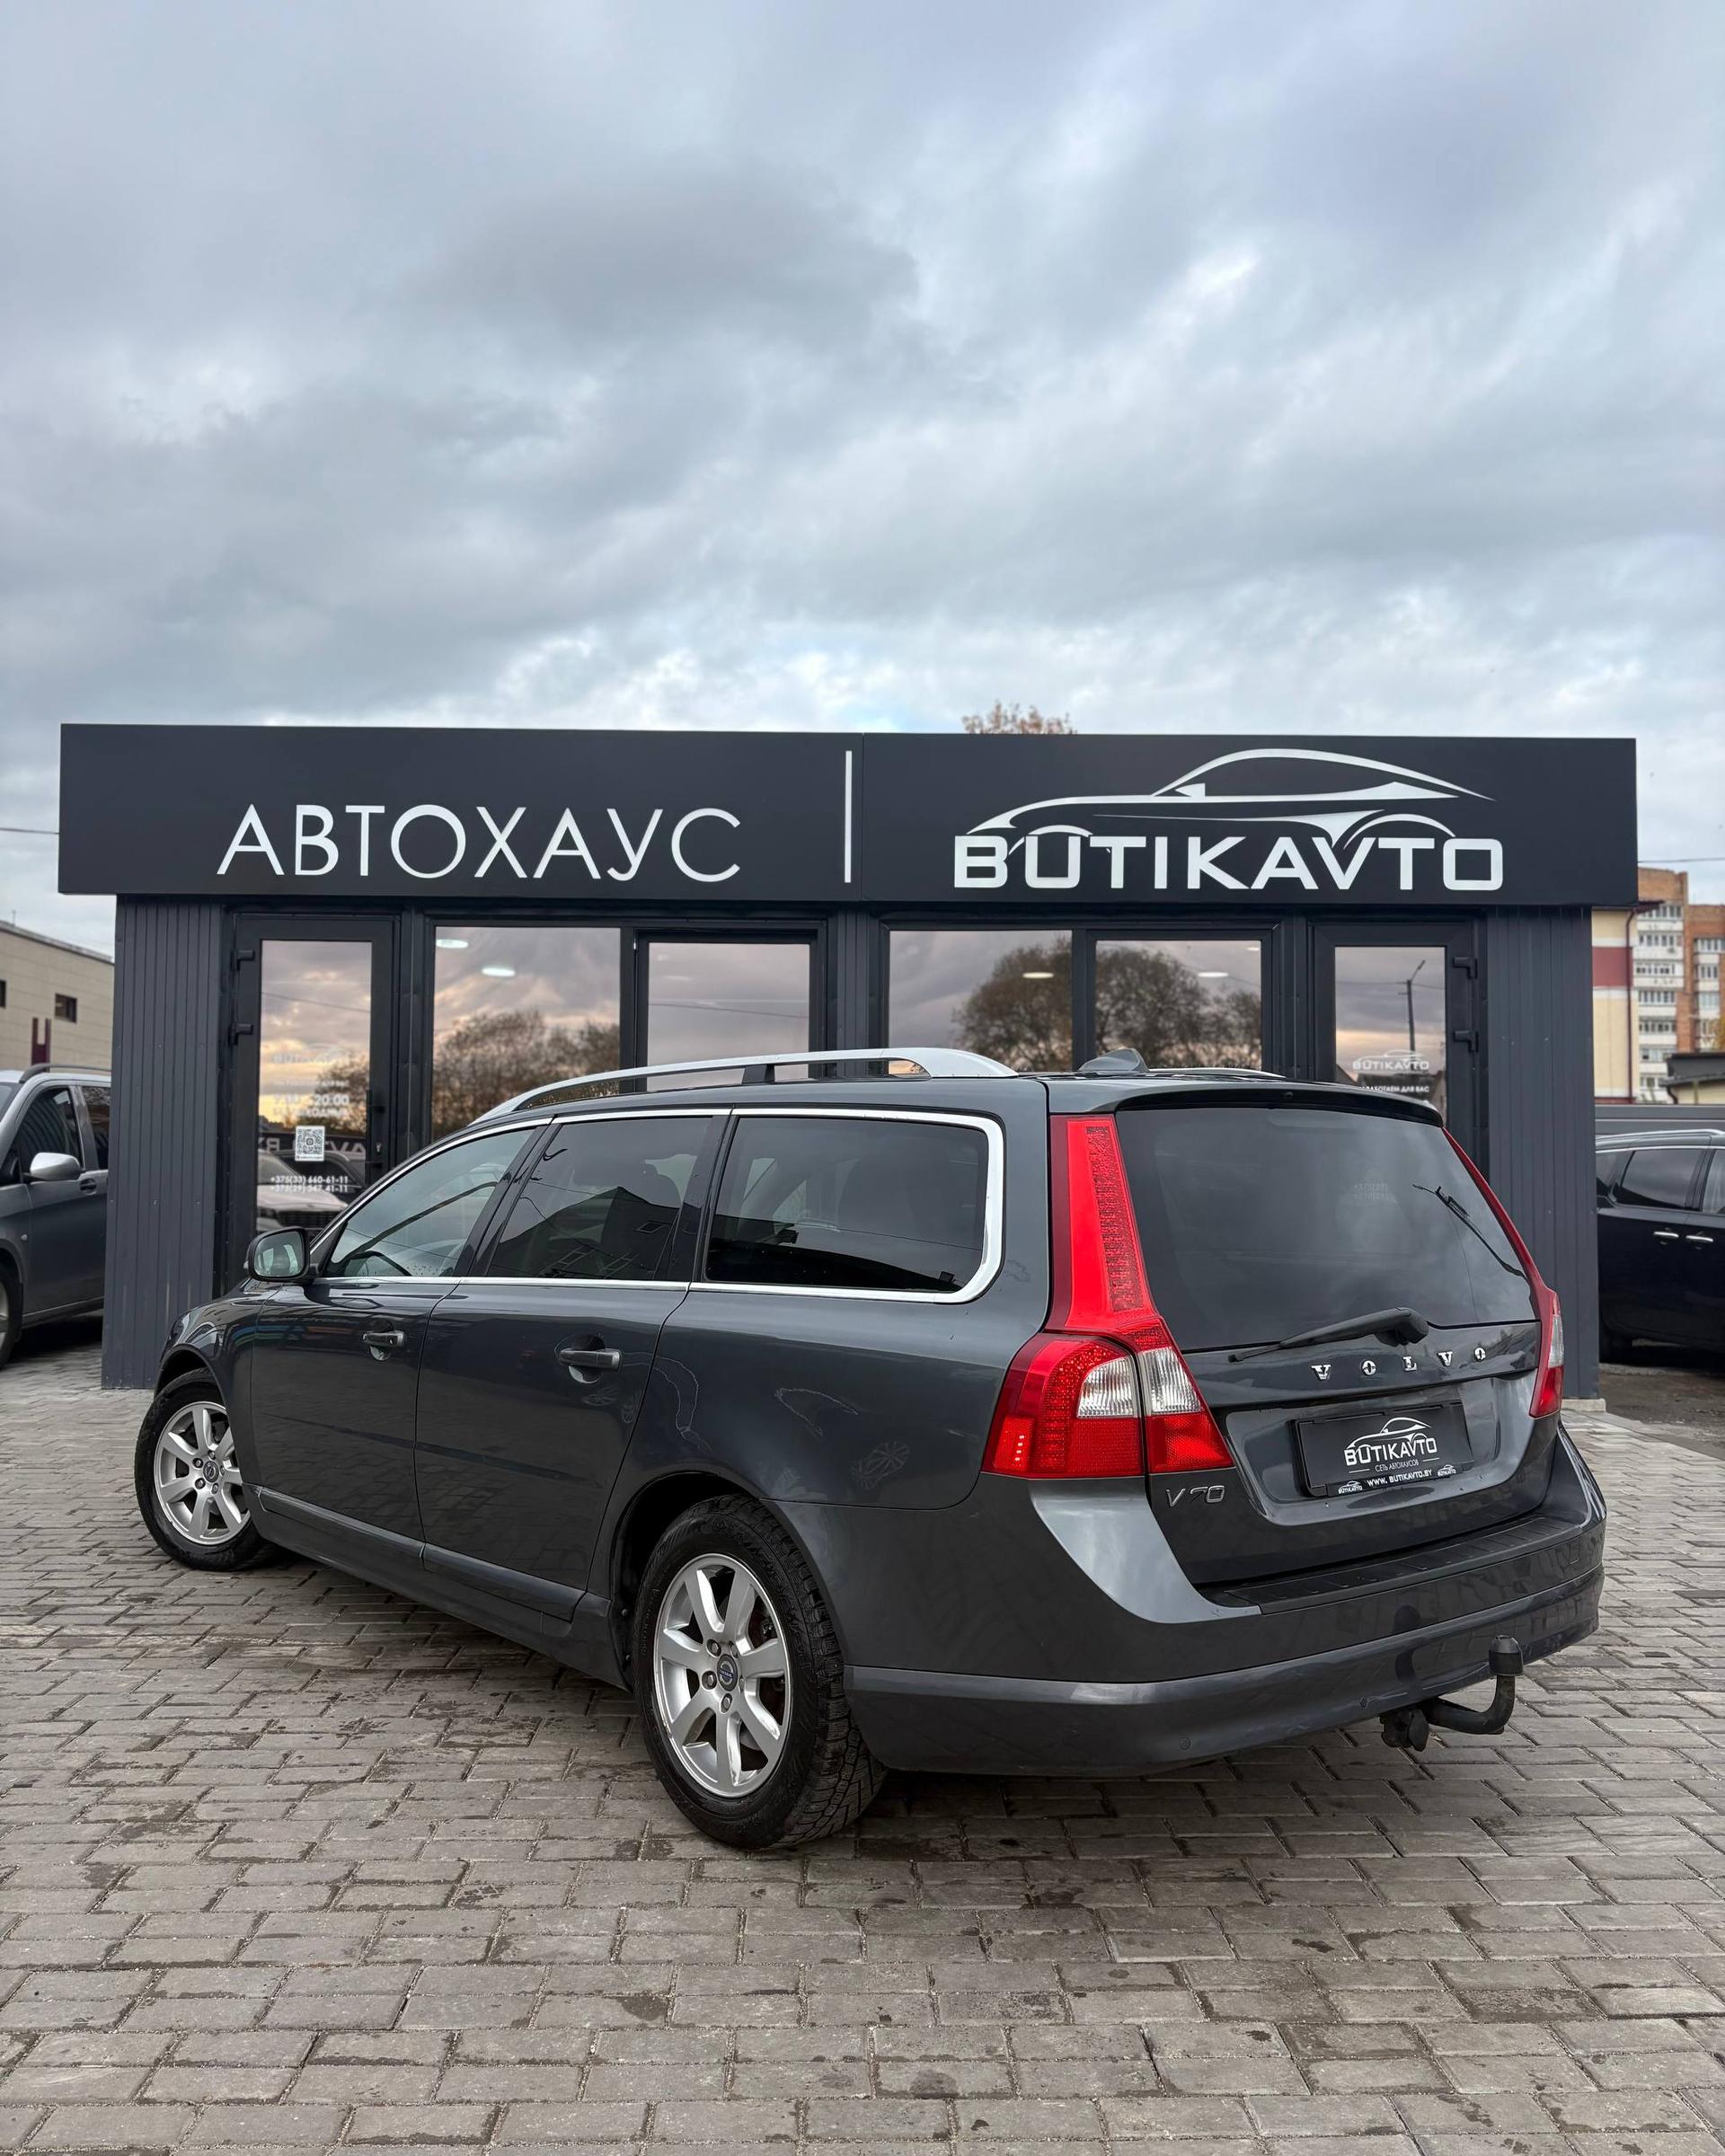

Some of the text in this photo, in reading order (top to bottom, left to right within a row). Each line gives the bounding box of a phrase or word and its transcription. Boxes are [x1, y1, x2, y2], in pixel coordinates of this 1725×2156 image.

[216, 803, 741, 883] АВТОХАУС
[954, 835, 1503, 892] BUTIKAVTO
[1352, 1060, 1429, 1071] BUTIKAVTO
[1311, 1348, 1487, 1381] VOLVO
[1344, 1437, 1438, 1467] BUTIKAVTO
[1165, 1484, 1225, 1507] V70
